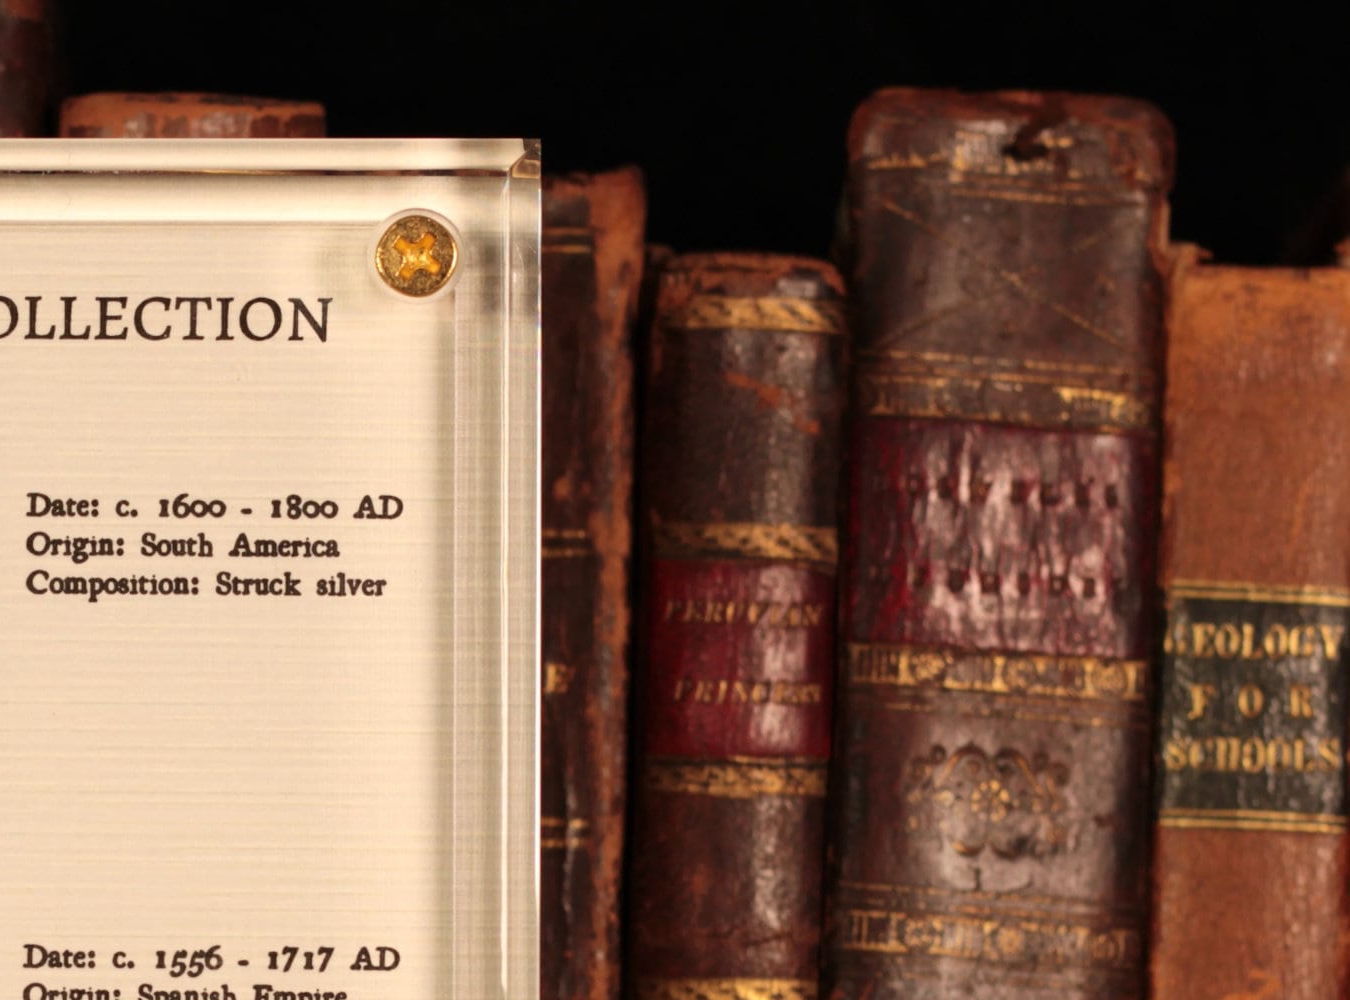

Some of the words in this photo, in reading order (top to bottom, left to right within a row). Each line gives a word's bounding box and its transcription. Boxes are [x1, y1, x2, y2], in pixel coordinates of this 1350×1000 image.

[25, 492, 99, 518] Date:
[115, 499, 139, 518] c.
[158, 493, 227, 519] 1600
[270, 494, 339, 520] 1800
[352, 494, 405, 520] AD
[25, 531, 125, 566] Origin:
[140, 532, 214, 558] South
[228, 532, 341, 559] America
[25, 569, 199, 603] Composition:
[215, 571, 302, 597] Struck
[316, 572, 387, 597] silver
[1187, 683, 1314, 720] FOR
[22, 943, 96, 969] Date:
[112, 951, 135, 969] c.
[155, 944, 223, 978] 1556
[237, 959, 249, 967] -
[267, 945, 335, 973] 1717
[349, 946, 402, 972] AD
